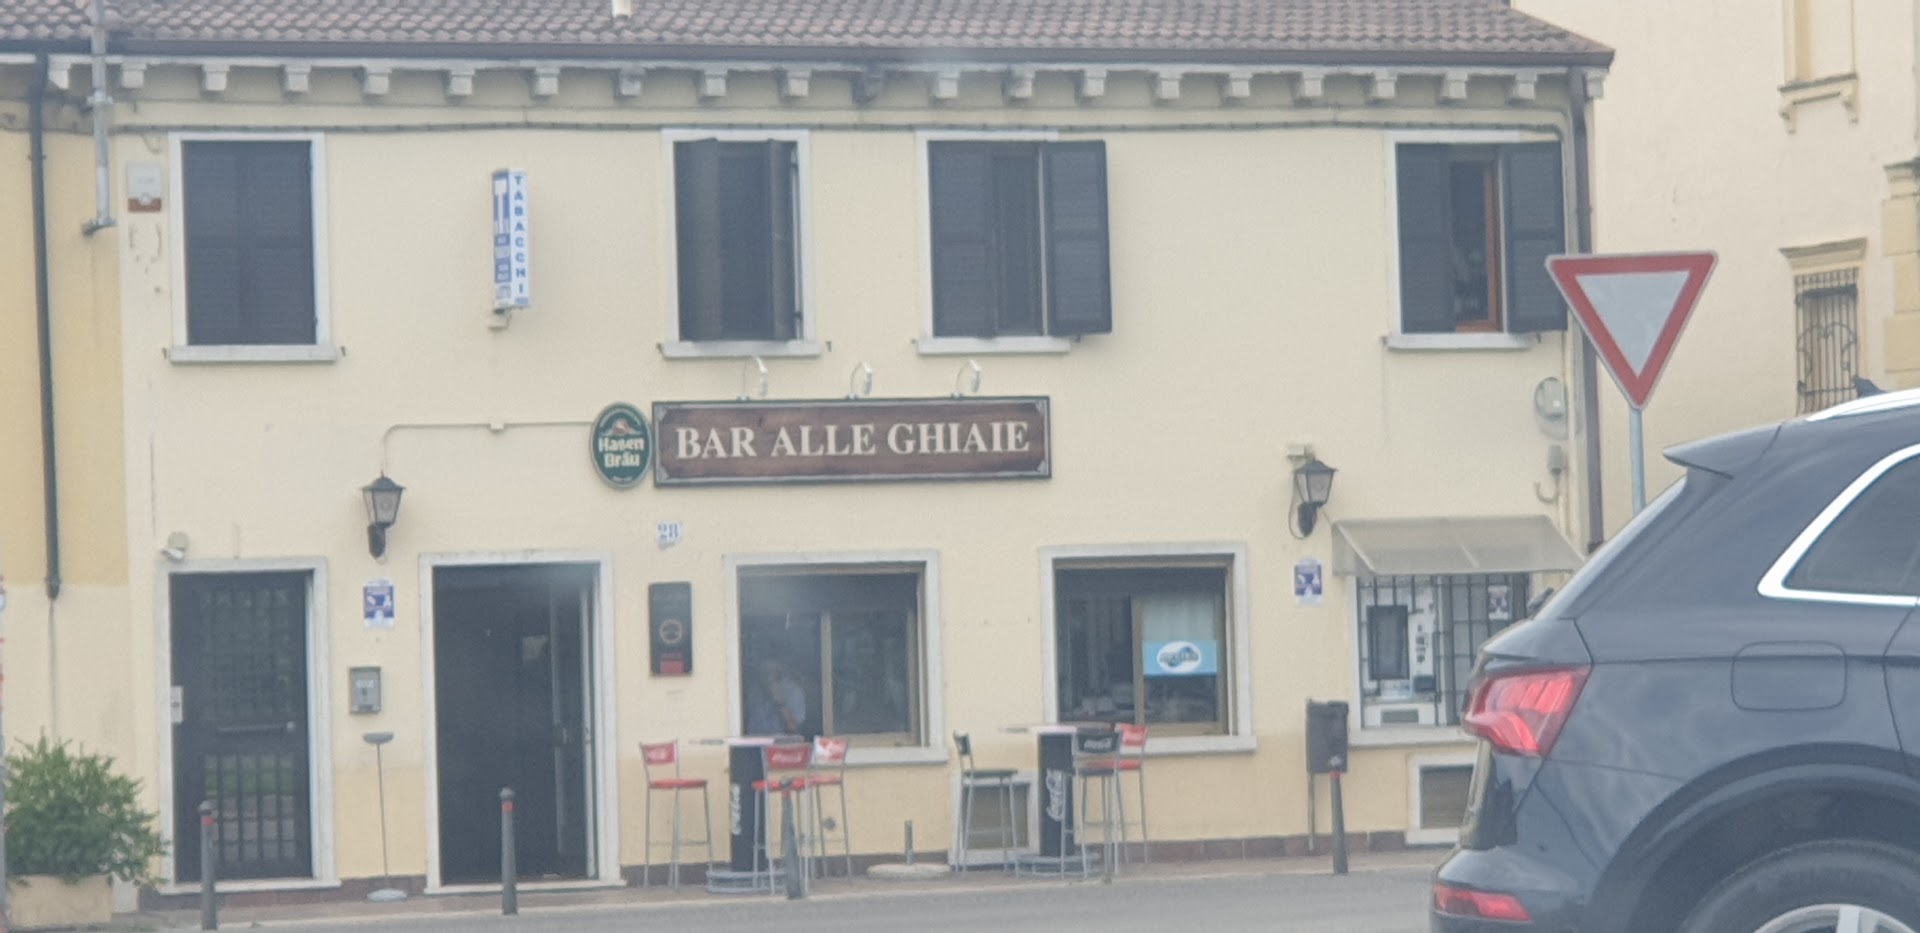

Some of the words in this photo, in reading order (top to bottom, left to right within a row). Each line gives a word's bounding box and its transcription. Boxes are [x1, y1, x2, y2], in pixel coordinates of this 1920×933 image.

[514, 176, 526, 293] TABACCHI
[676, 425, 758, 460] BAR
[771, 423, 876, 457] ALLE
[887, 419, 1031, 455] GHIAIE
[657, 523, 679, 539] 28
